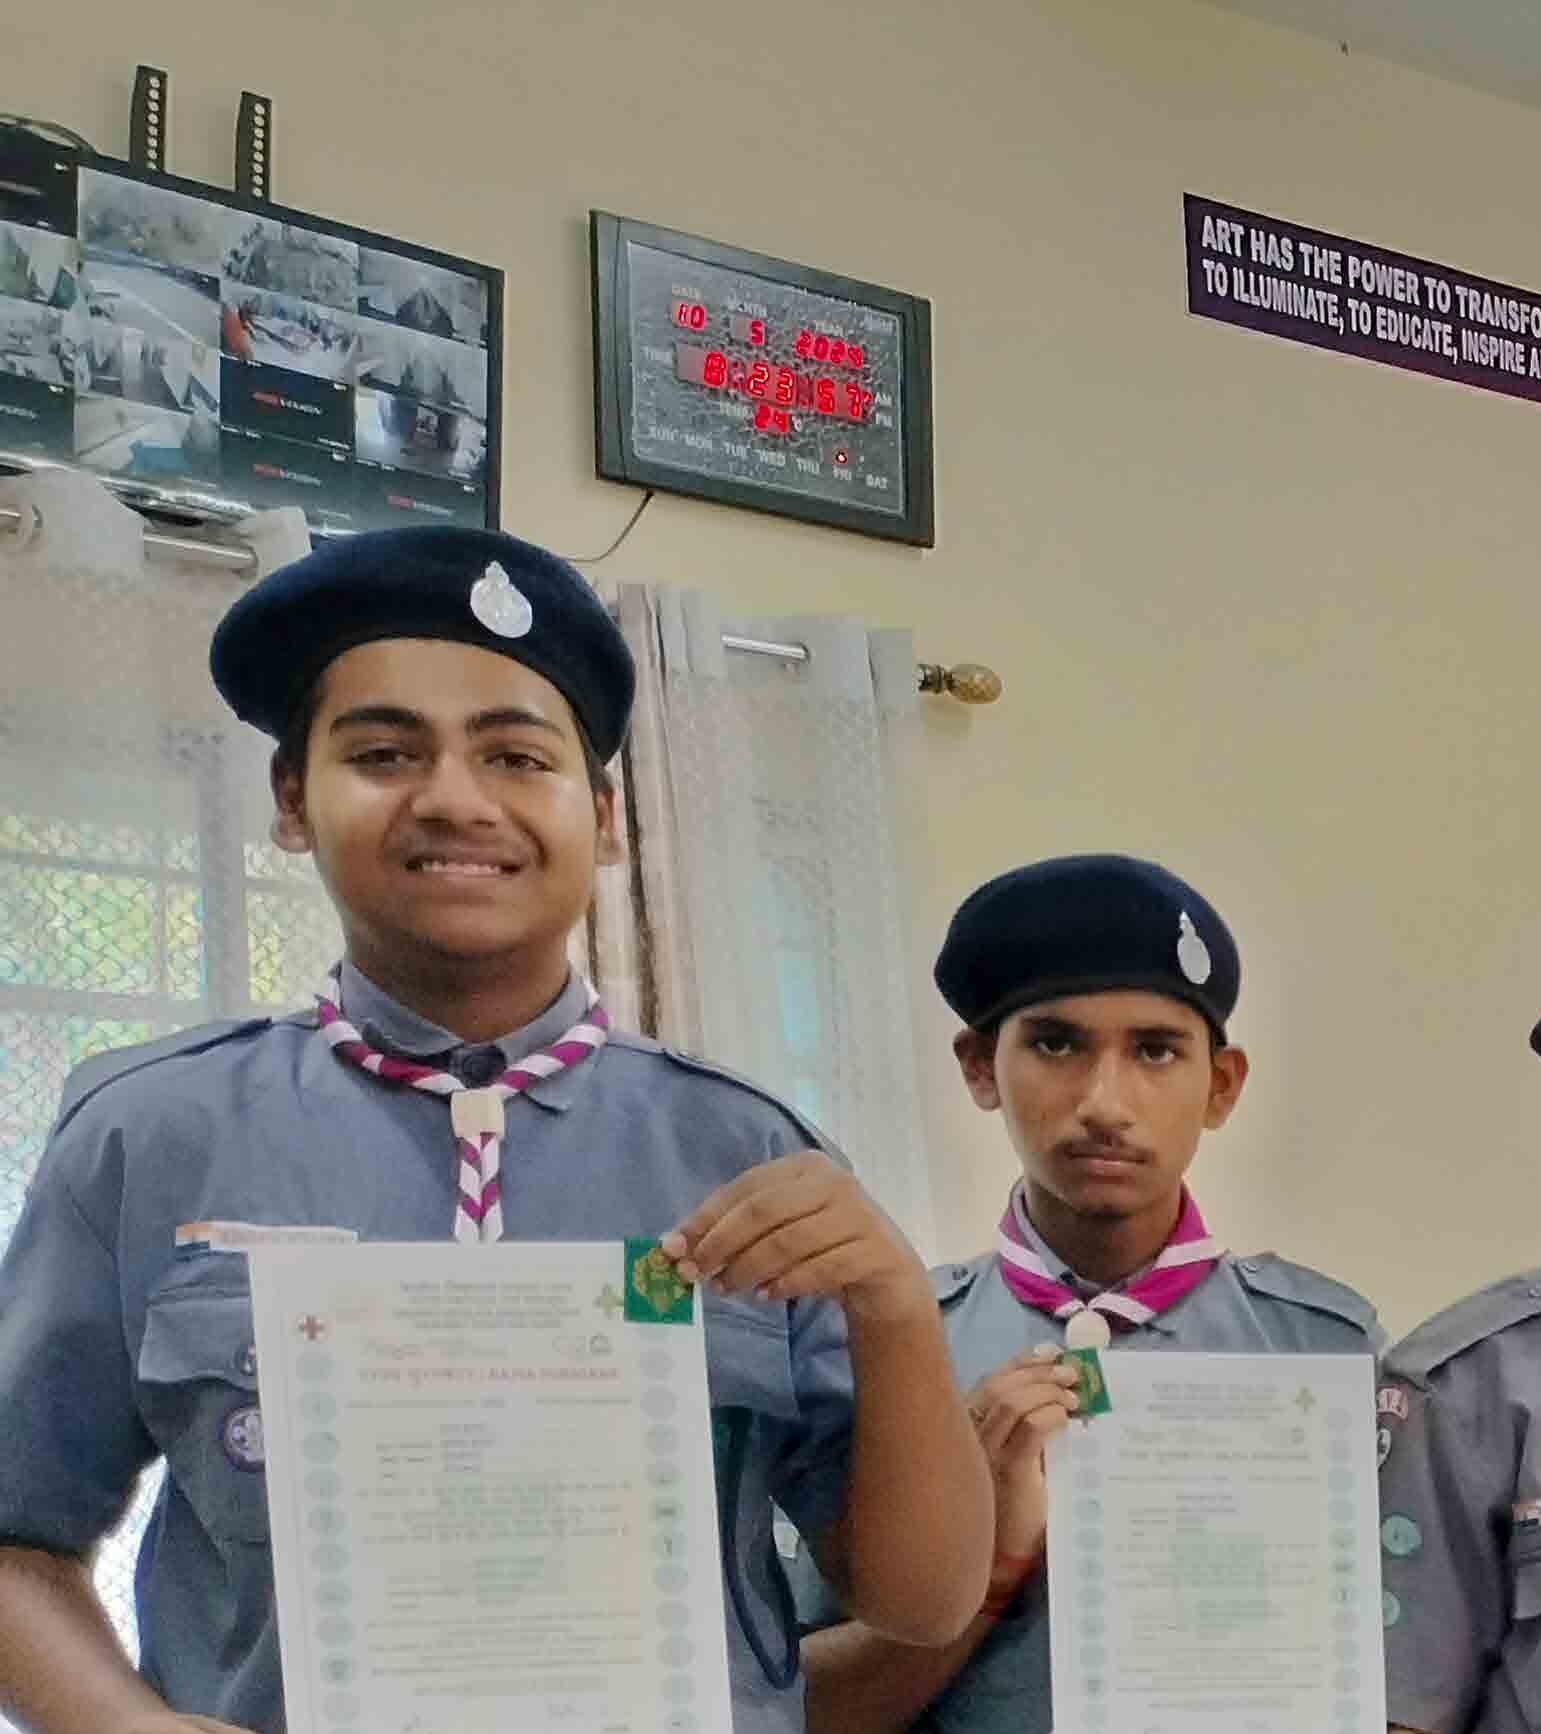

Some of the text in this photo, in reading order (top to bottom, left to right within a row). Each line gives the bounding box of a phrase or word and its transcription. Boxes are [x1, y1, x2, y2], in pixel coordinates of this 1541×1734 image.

[1201, 215, 1244, 257] ART
[1250, 230, 1293, 270] HAS
[1300, 243, 1341, 283] THE
[1349, 256, 1420, 306] POWER
[1425, 276, 1451, 313] TO
[677, 303, 864, 368] 10 5 2024
[1202, 259, 1227, 295] TO
[1233, 267, 1344, 335] ILLUMINATE,
[1348, 298, 1371, 334] TO
[1376, 306, 1459, 364] EDUCATE,
[1462, 328, 1525, 375] INSPIRE
